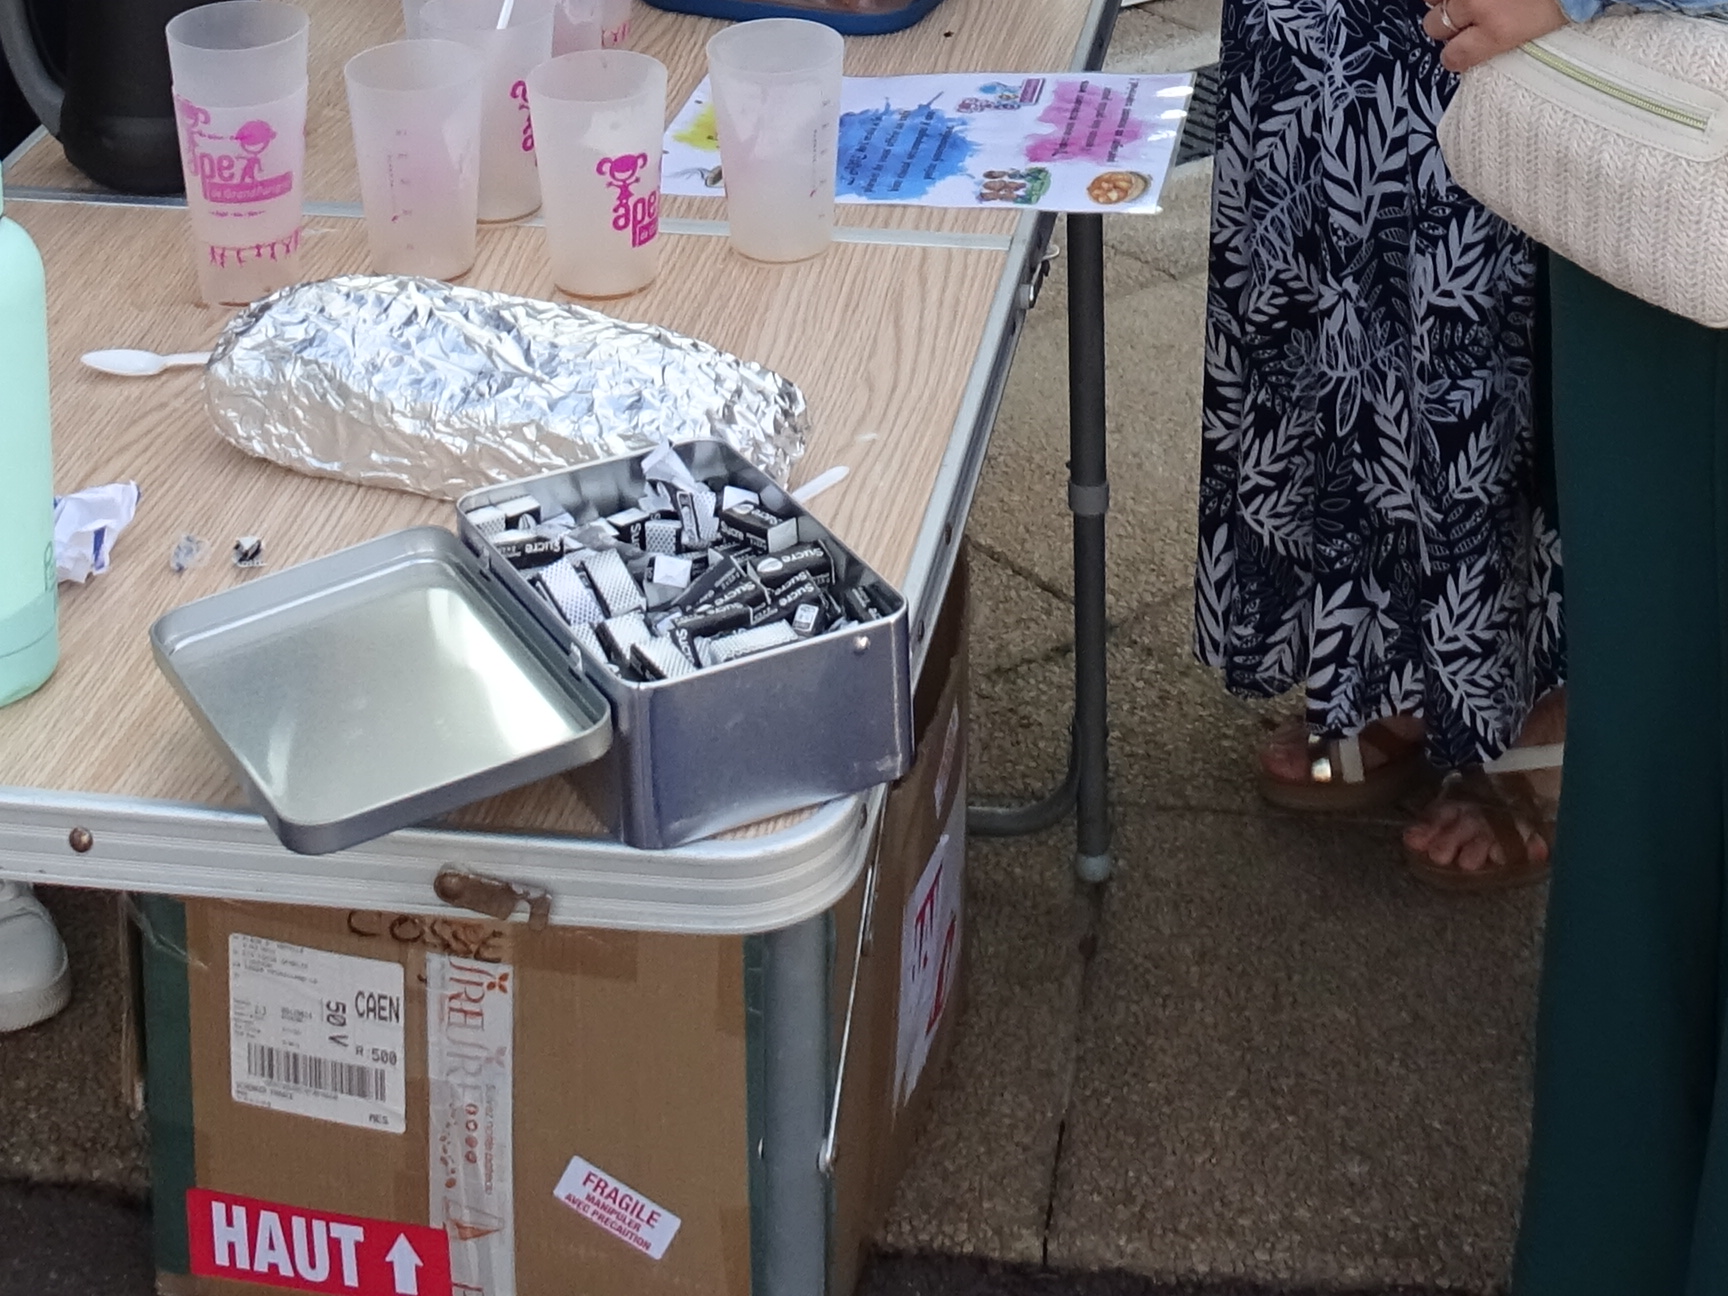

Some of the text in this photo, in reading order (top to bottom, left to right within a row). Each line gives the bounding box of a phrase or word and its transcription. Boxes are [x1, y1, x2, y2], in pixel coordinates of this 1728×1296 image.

[524, 540, 561, 554] Sucre
[781, 547, 824, 564] Sucre
[714, 580, 756, 606] Sucre
[774, 570, 808, 596] Sucre
[778, 582, 815, 607] Sucre
[355, 990, 400, 1024] CAEN
[582, 1171, 661, 1229] FRAGILE
[585, 1193, 642, 1233] MANIPULER
[564, 1193, 652, 1251] AVEC PRECAUTION
[212, 1201, 364, 1288] HAUT
